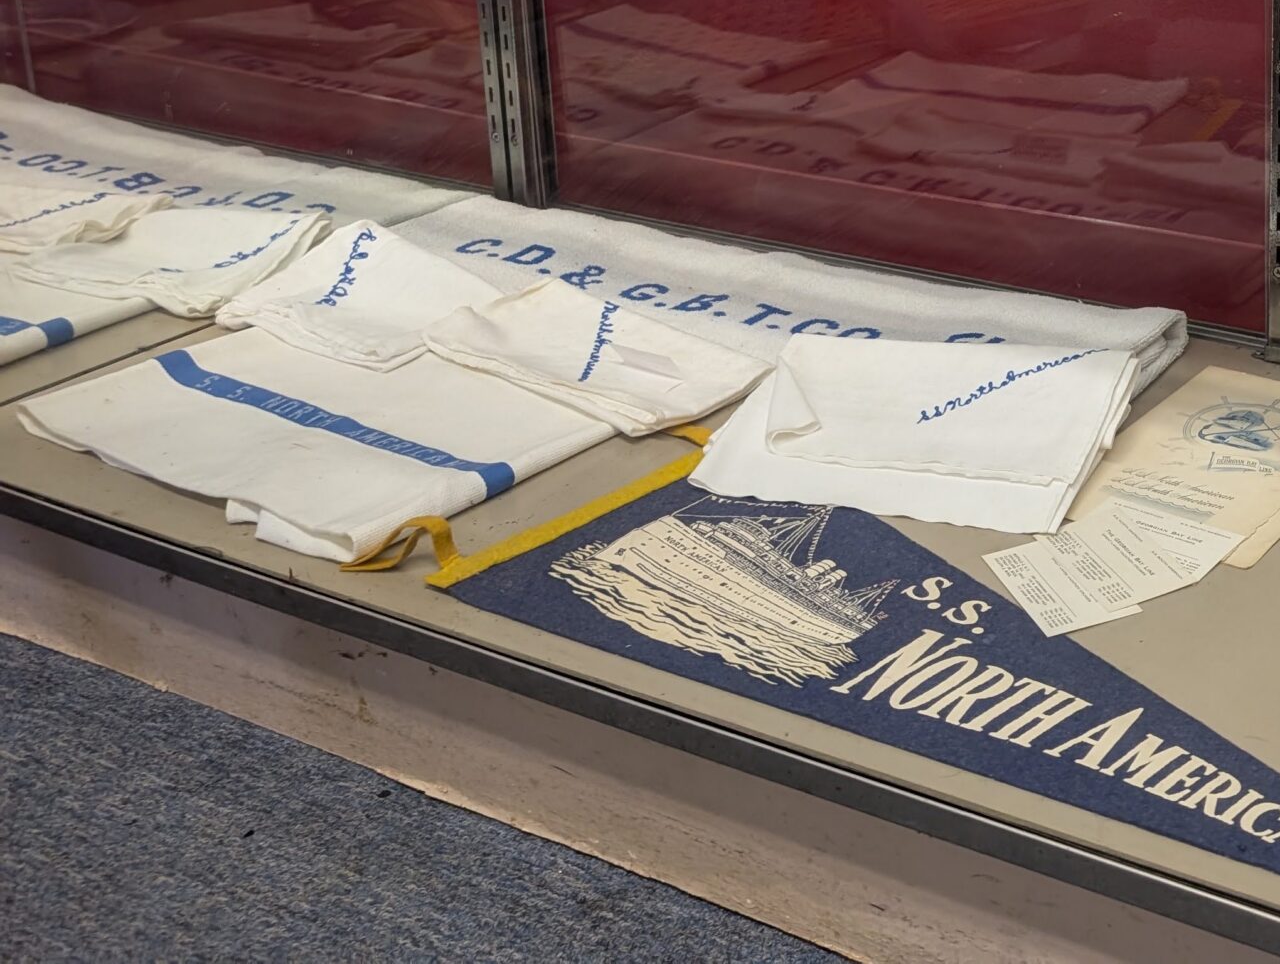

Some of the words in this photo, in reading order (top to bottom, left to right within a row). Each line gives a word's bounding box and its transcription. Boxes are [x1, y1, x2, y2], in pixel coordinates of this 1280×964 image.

[559, 264, 606, 290] &
[260, 395, 344, 428] NORTH
[664, 534, 690, 553] NORTH
[687, 550, 729, 574] AMERICAN
[902, 575, 992, 635] S.S.
[829, 628, 1094, 750] NORTH
